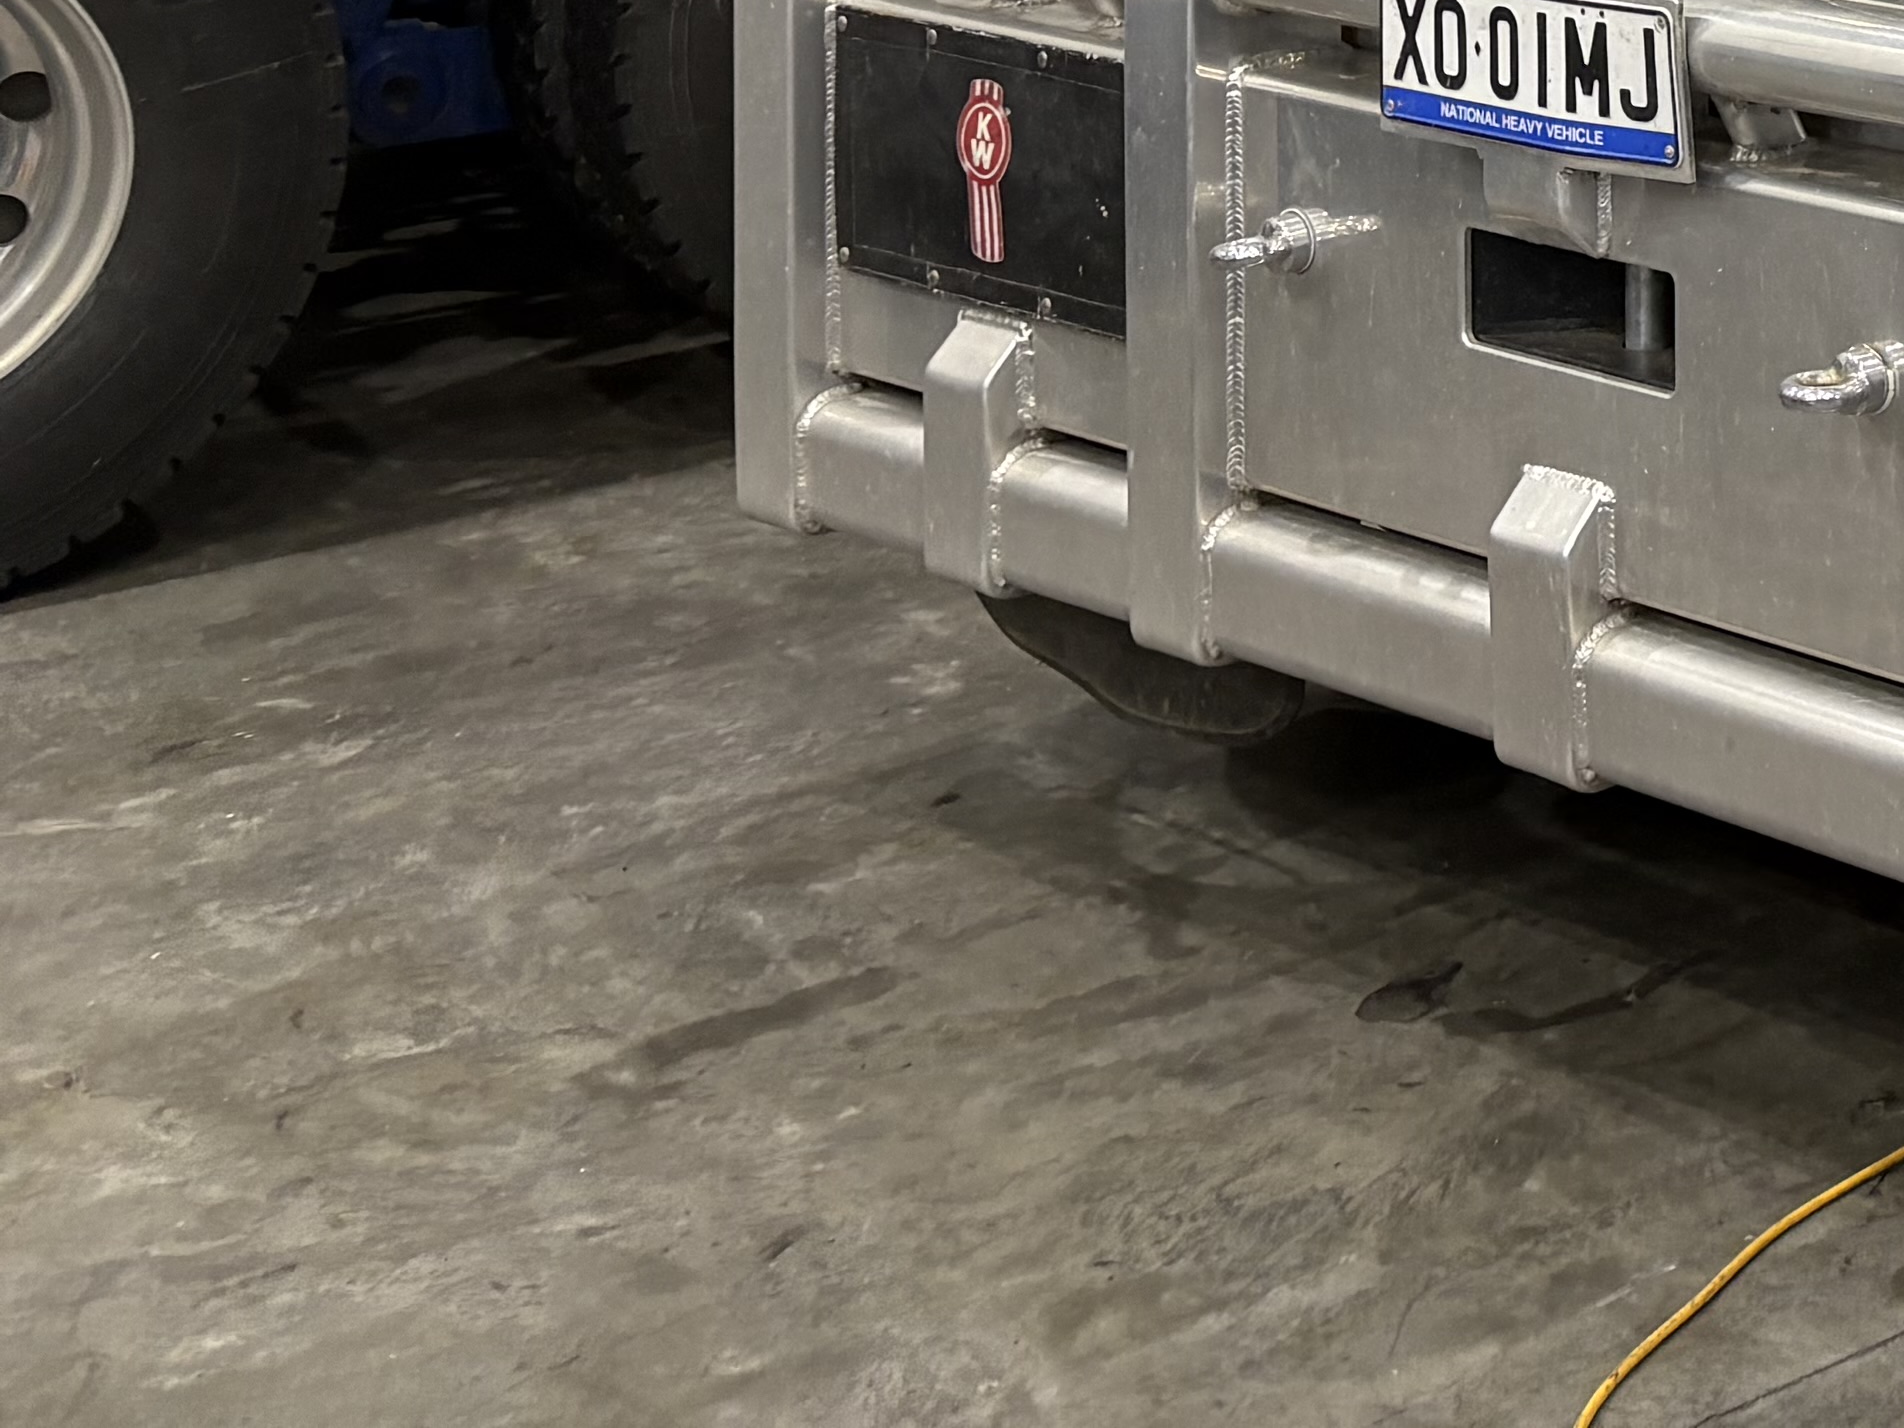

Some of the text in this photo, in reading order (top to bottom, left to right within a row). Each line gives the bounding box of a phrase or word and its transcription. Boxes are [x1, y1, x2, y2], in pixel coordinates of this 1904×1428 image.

[1440, 101, 1604, 146] NATIONAL HEAVY VEHICLE
